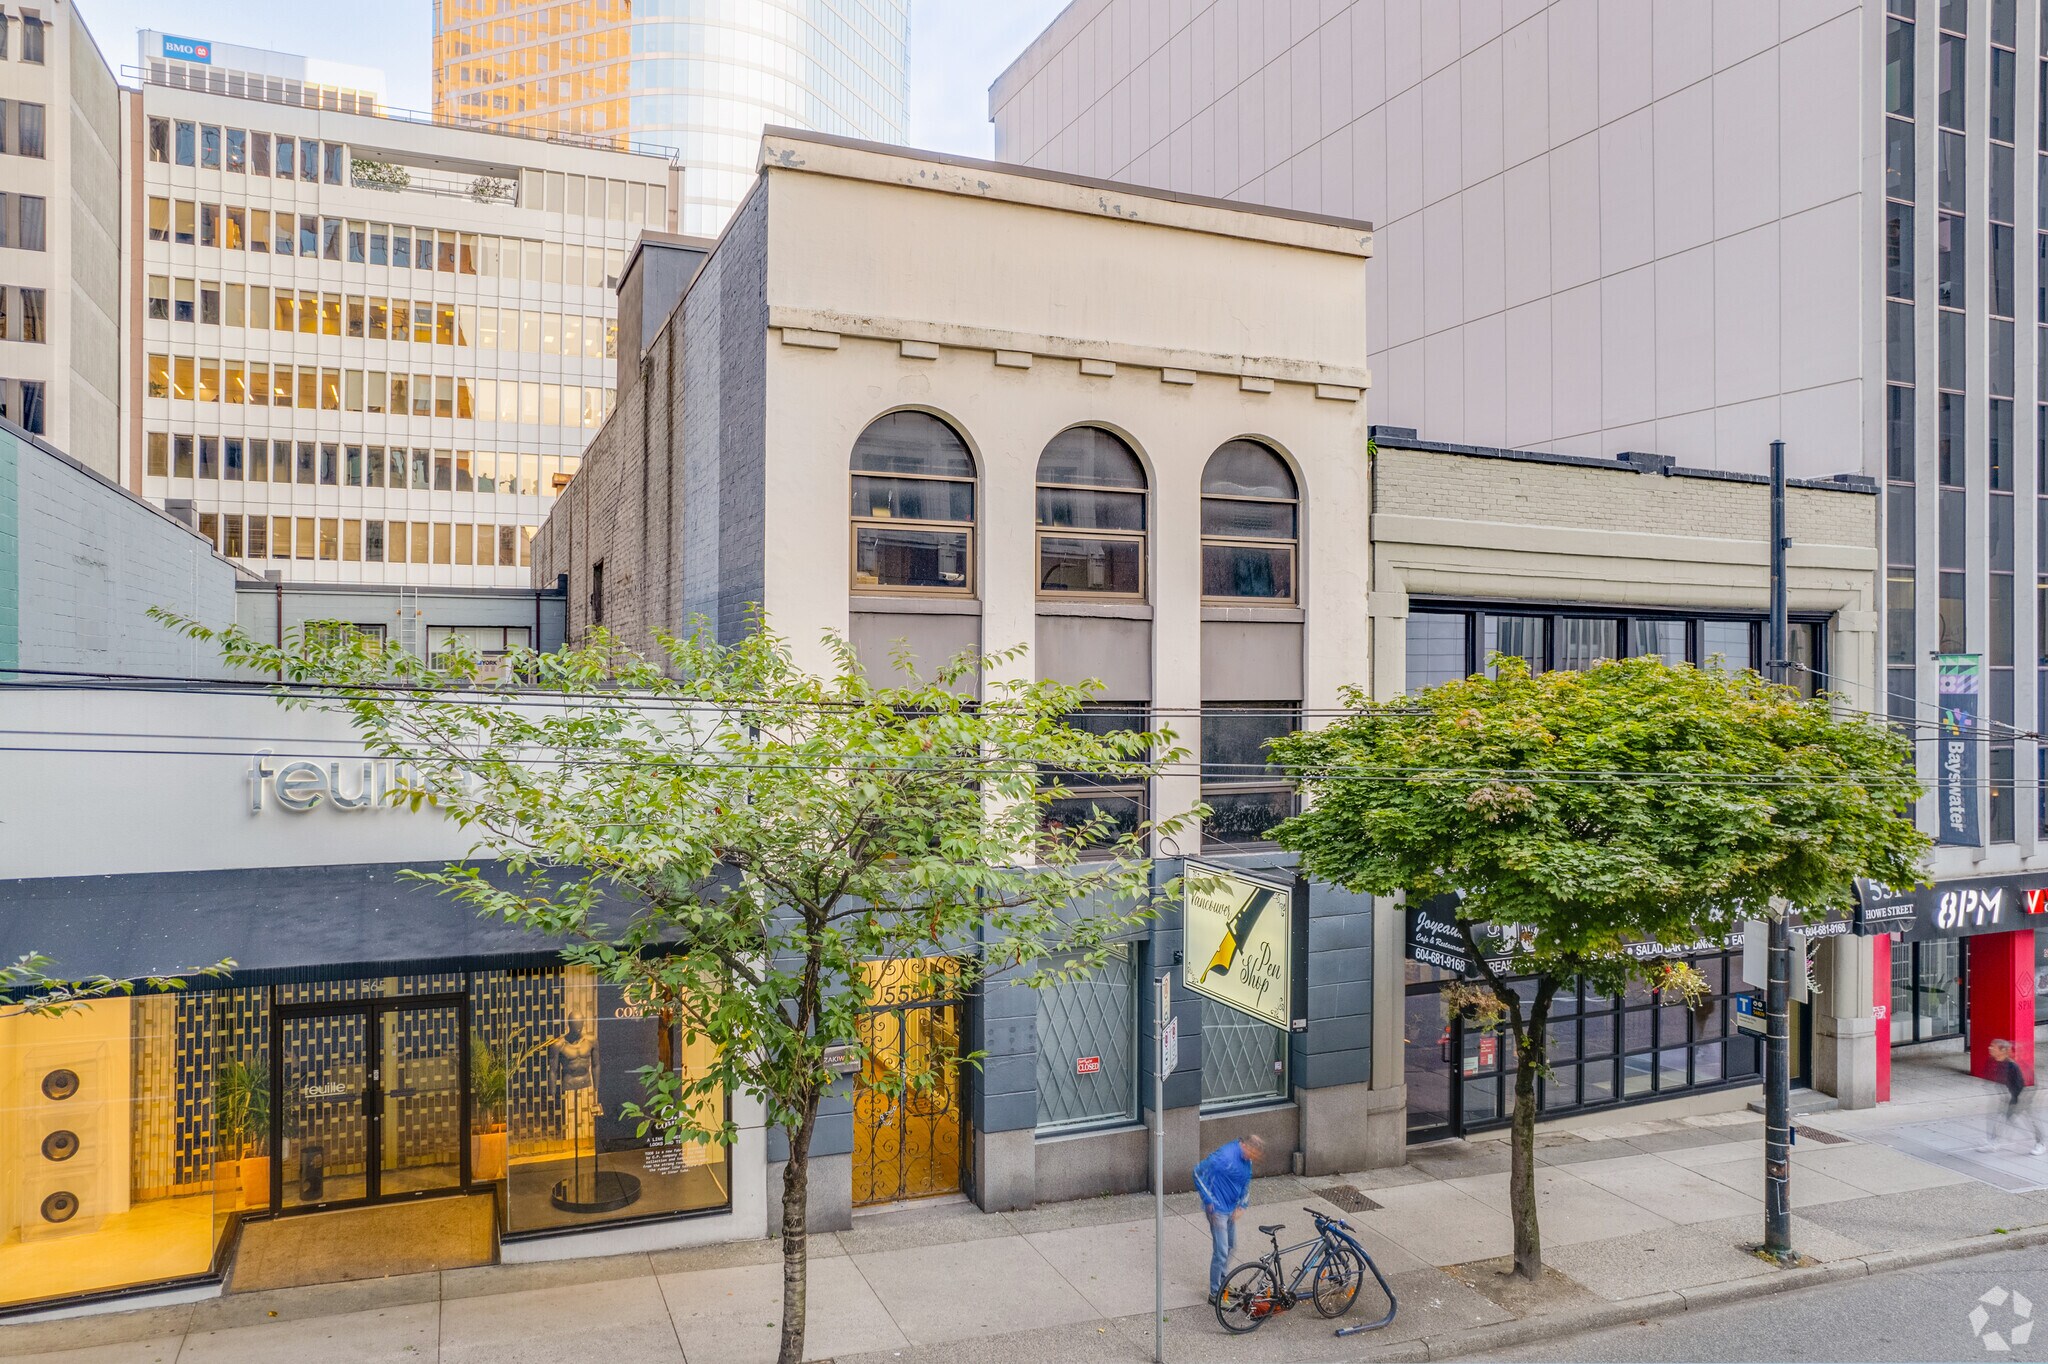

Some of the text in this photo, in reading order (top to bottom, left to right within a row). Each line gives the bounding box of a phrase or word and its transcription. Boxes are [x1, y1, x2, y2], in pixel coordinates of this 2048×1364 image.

[165, 42, 194, 54] BMO
[248, 749, 474, 811] feuille
[1944, 741, 1966, 832] Bayswater
[1190, 891, 1232, 921] Vancouver
[1865, 904, 1914, 919] HOWE STREET
[1938, 888, 2003, 929] 8PM
[1435, 938, 1466, 954] Restaurant
[1635, 943, 1663, 956] SALAD
[1804, 923, 1847, 936] 604-681-9168
[1257, 941, 1282, 979] Pen
[1415, 947, 1466, 972] 604-681-9168
[1239, 955, 1269, 1008] Shop
[823, 1055, 855, 1063] ZAKIWN
[1078, 1063, 1099, 1071] CLOSED
[304, 1082, 346, 1097] feuille
